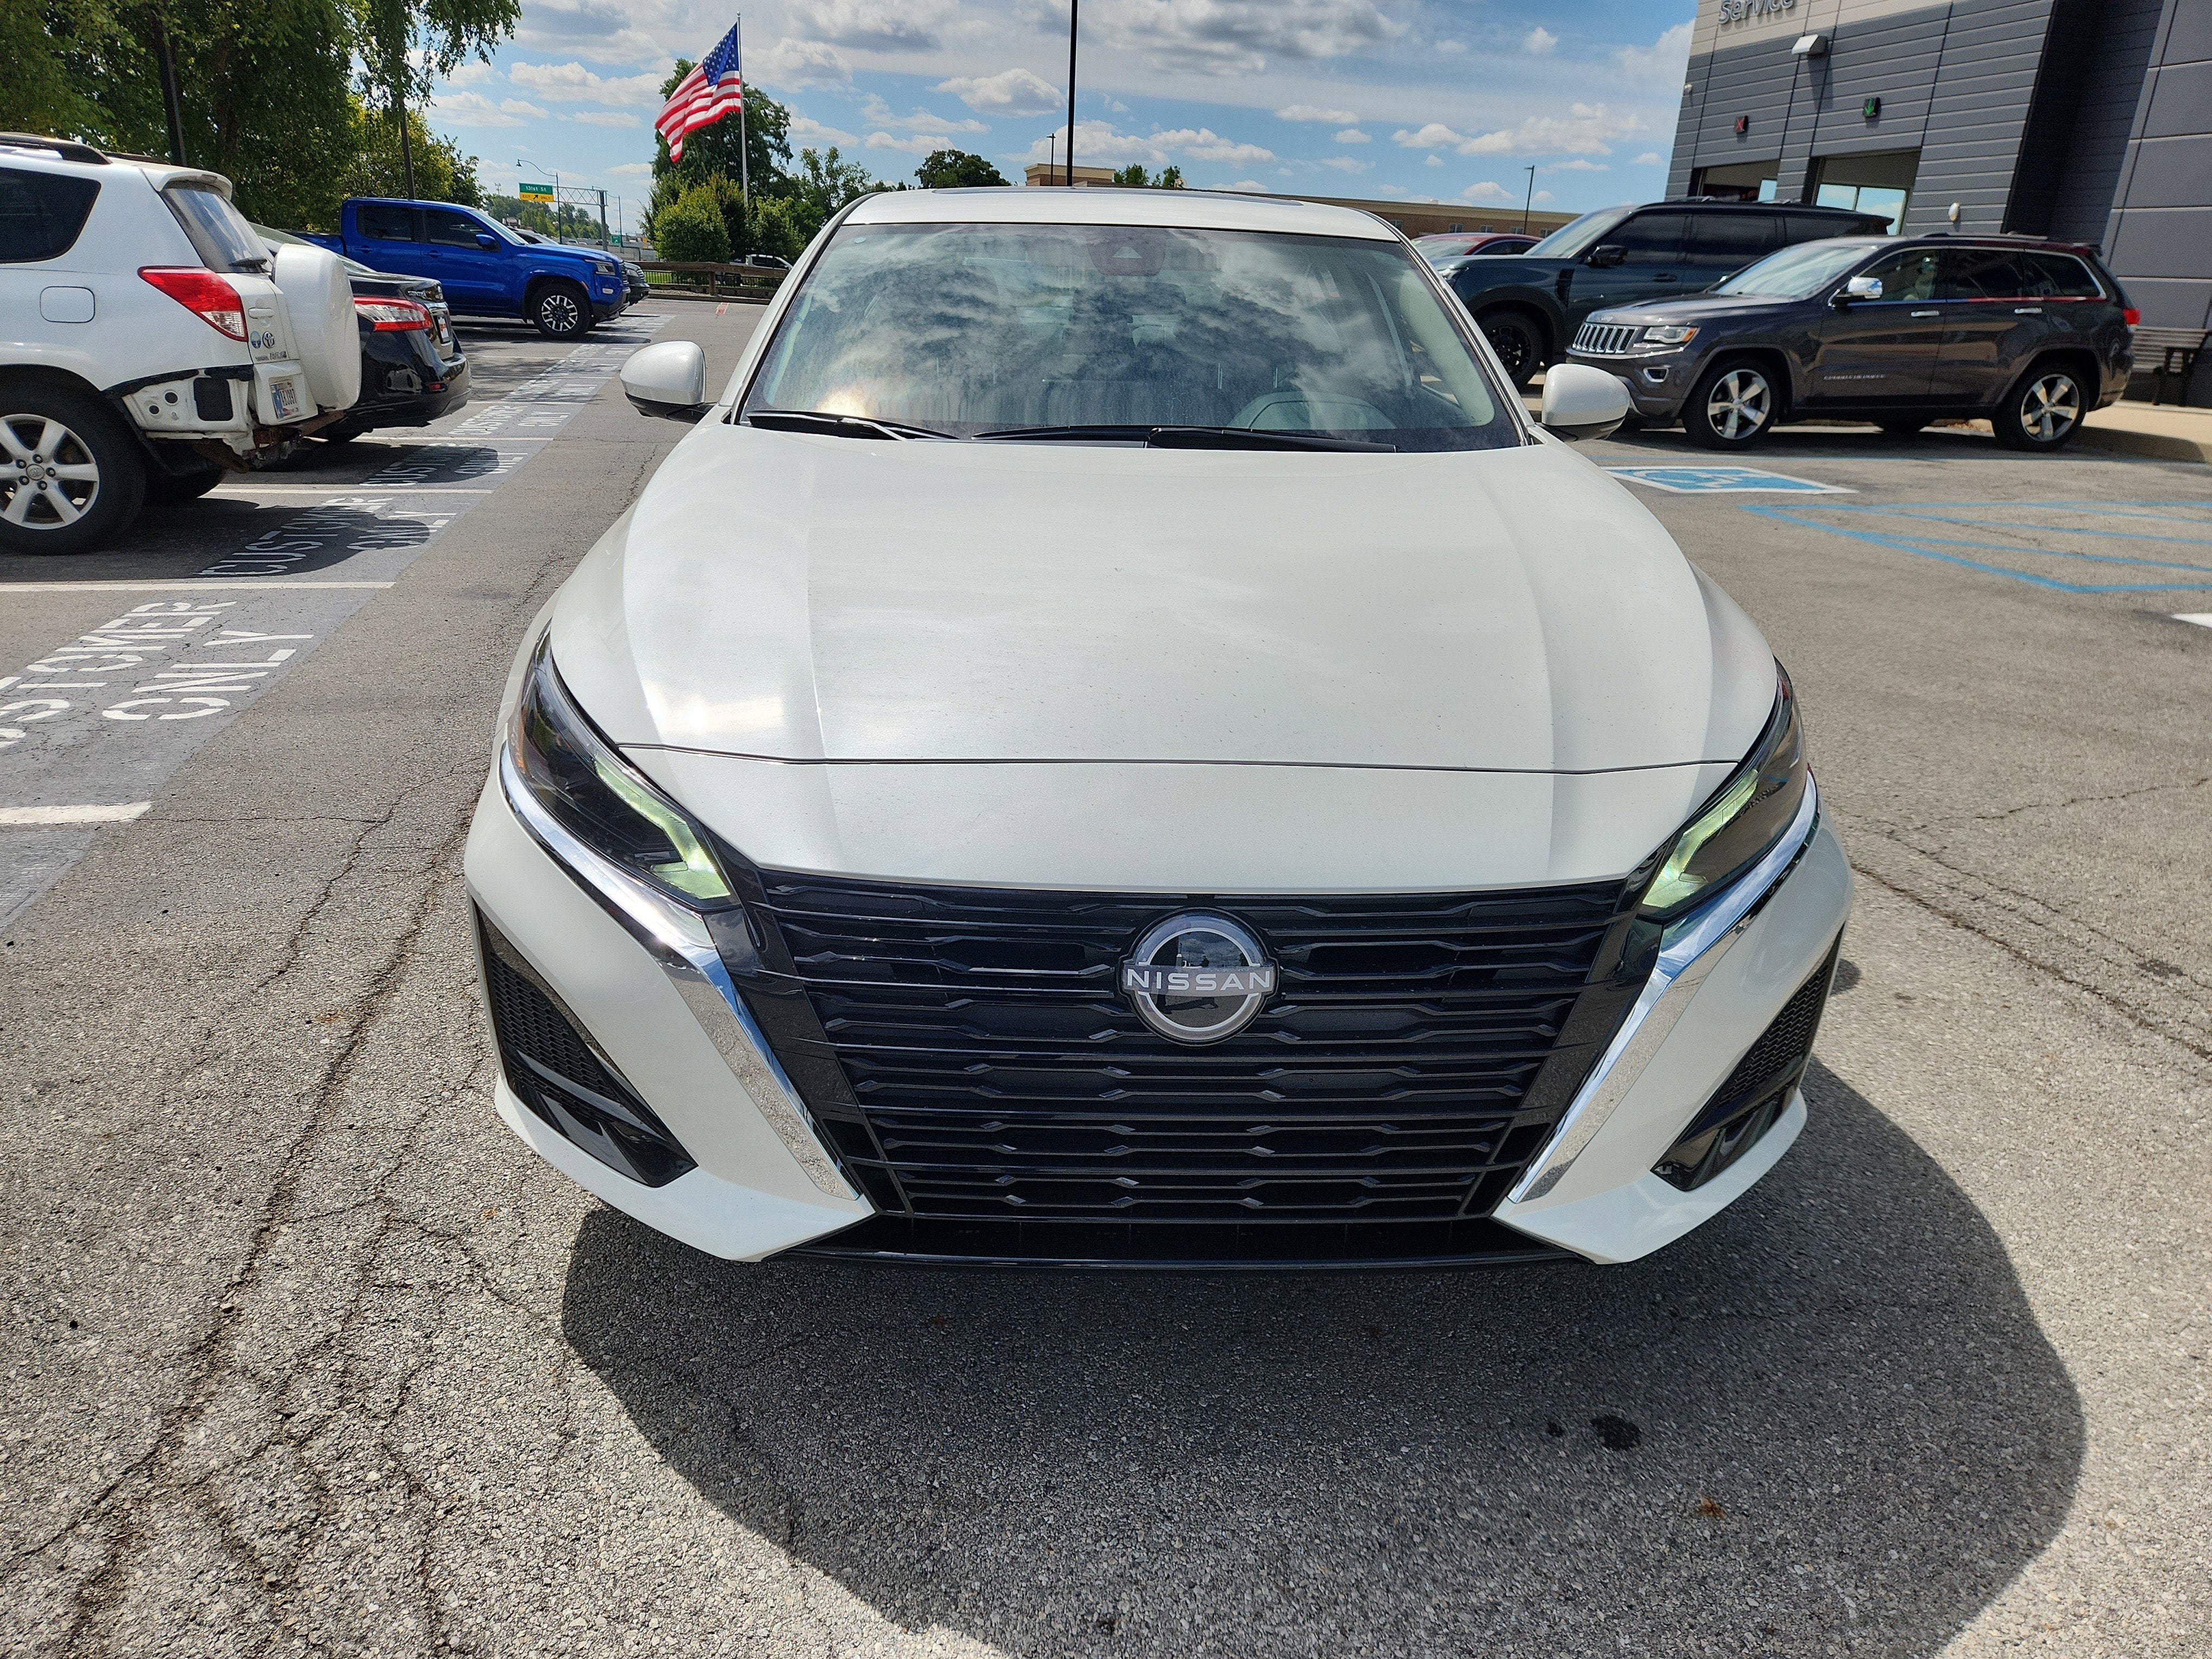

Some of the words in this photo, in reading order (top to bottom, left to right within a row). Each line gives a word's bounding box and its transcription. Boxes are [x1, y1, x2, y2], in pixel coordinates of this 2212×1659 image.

[448, 406, 528, 435] CUSTOMER
[518, 411, 571, 426] ONLY
[454, 452, 528, 474] ONLY
[194, 498, 393, 575] CUSTOMER
[346, 511, 457, 550] ONLY
[0, 601, 237, 748] STOMER
[102, 630, 314, 721] ONLY
[1127, 968, 1270, 991] NISSAN
